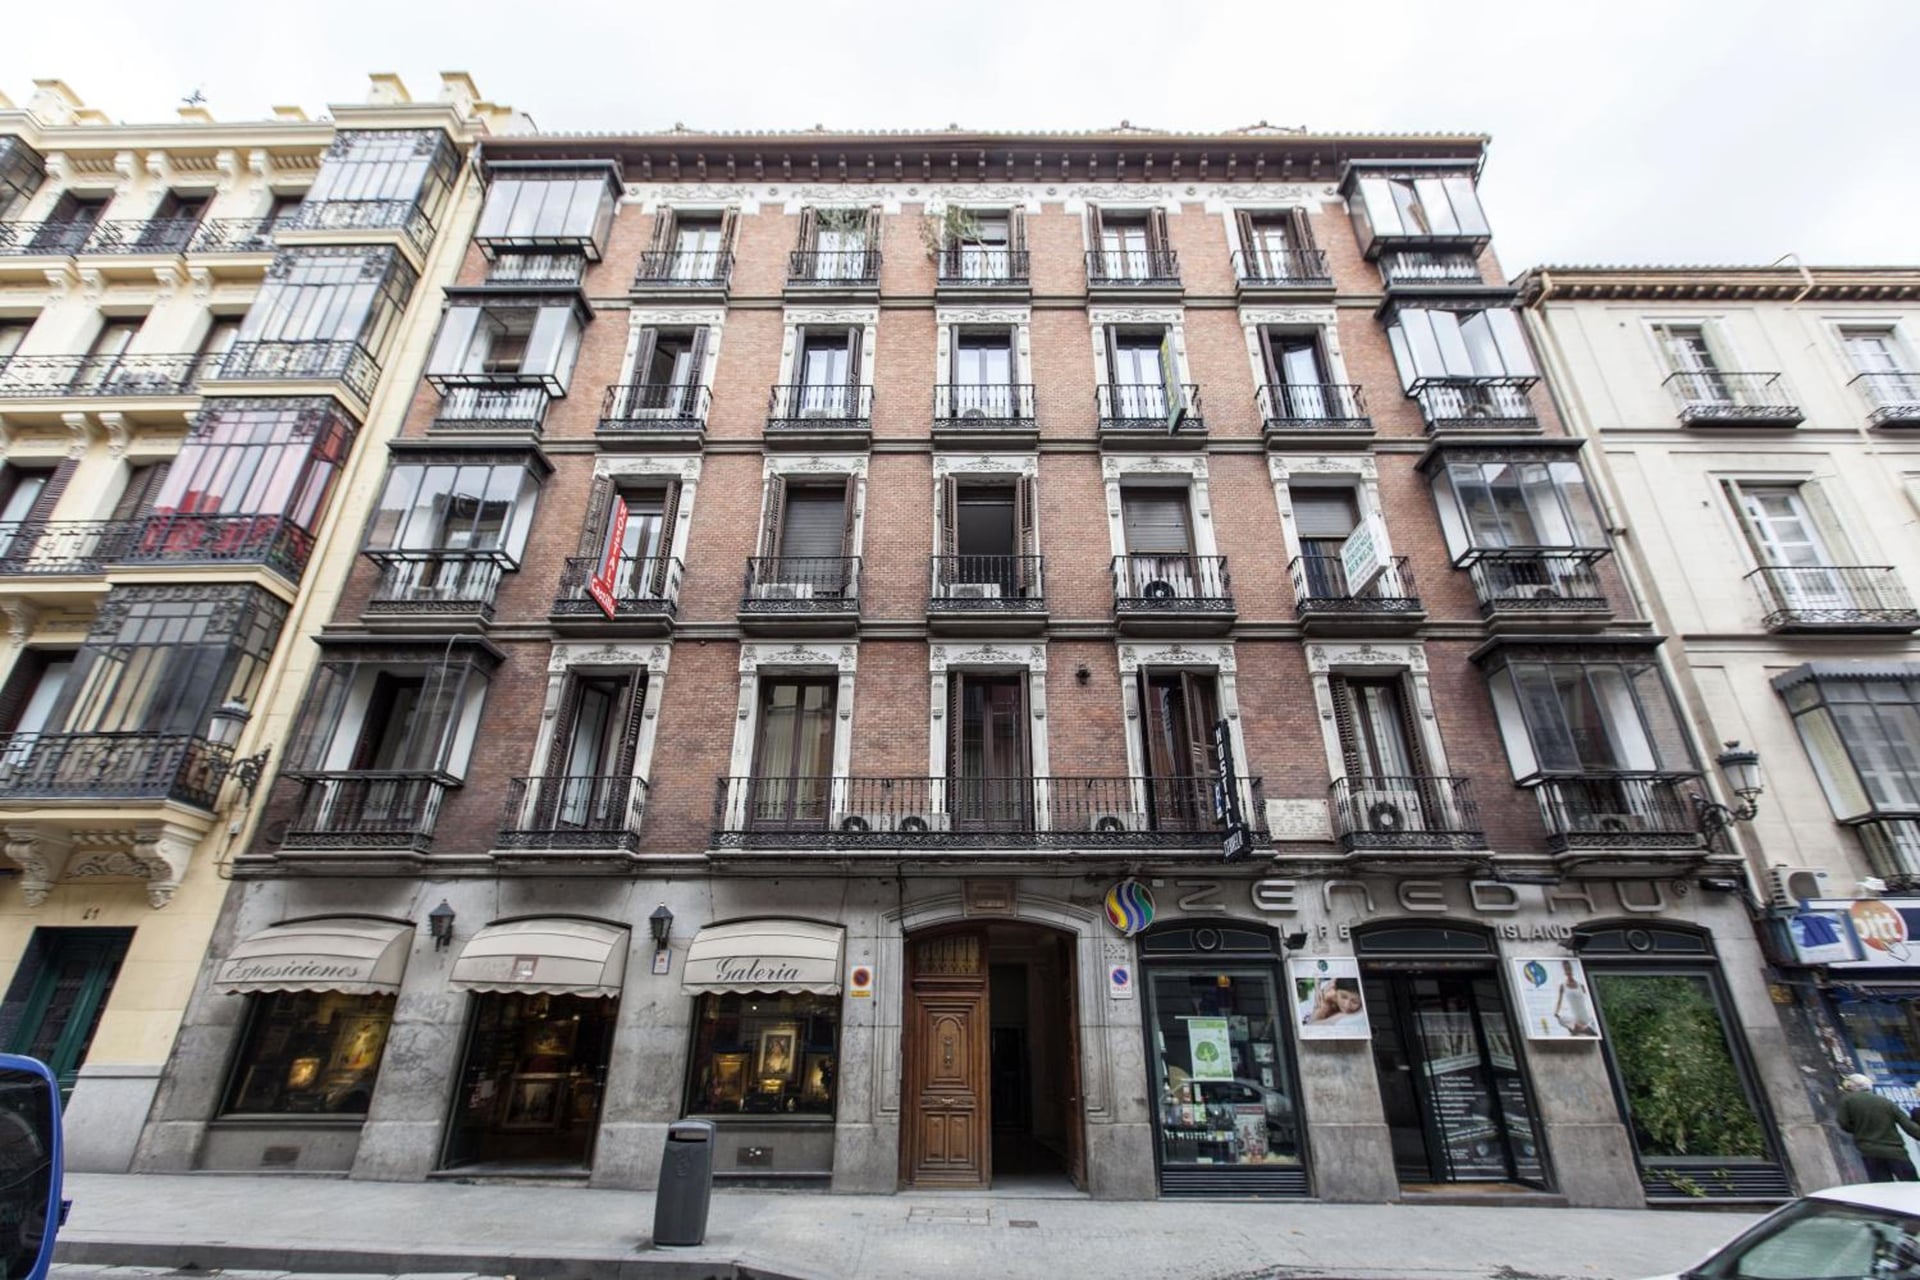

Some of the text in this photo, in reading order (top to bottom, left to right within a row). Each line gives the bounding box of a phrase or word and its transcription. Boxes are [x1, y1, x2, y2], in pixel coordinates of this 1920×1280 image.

[1215, 726, 1234, 830] HOSTAL
[1496, 923, 1573, 941] ISLAND
[226, 960, 358, 982] Exposiciones
[715, 957, 801, 981] Galeria
